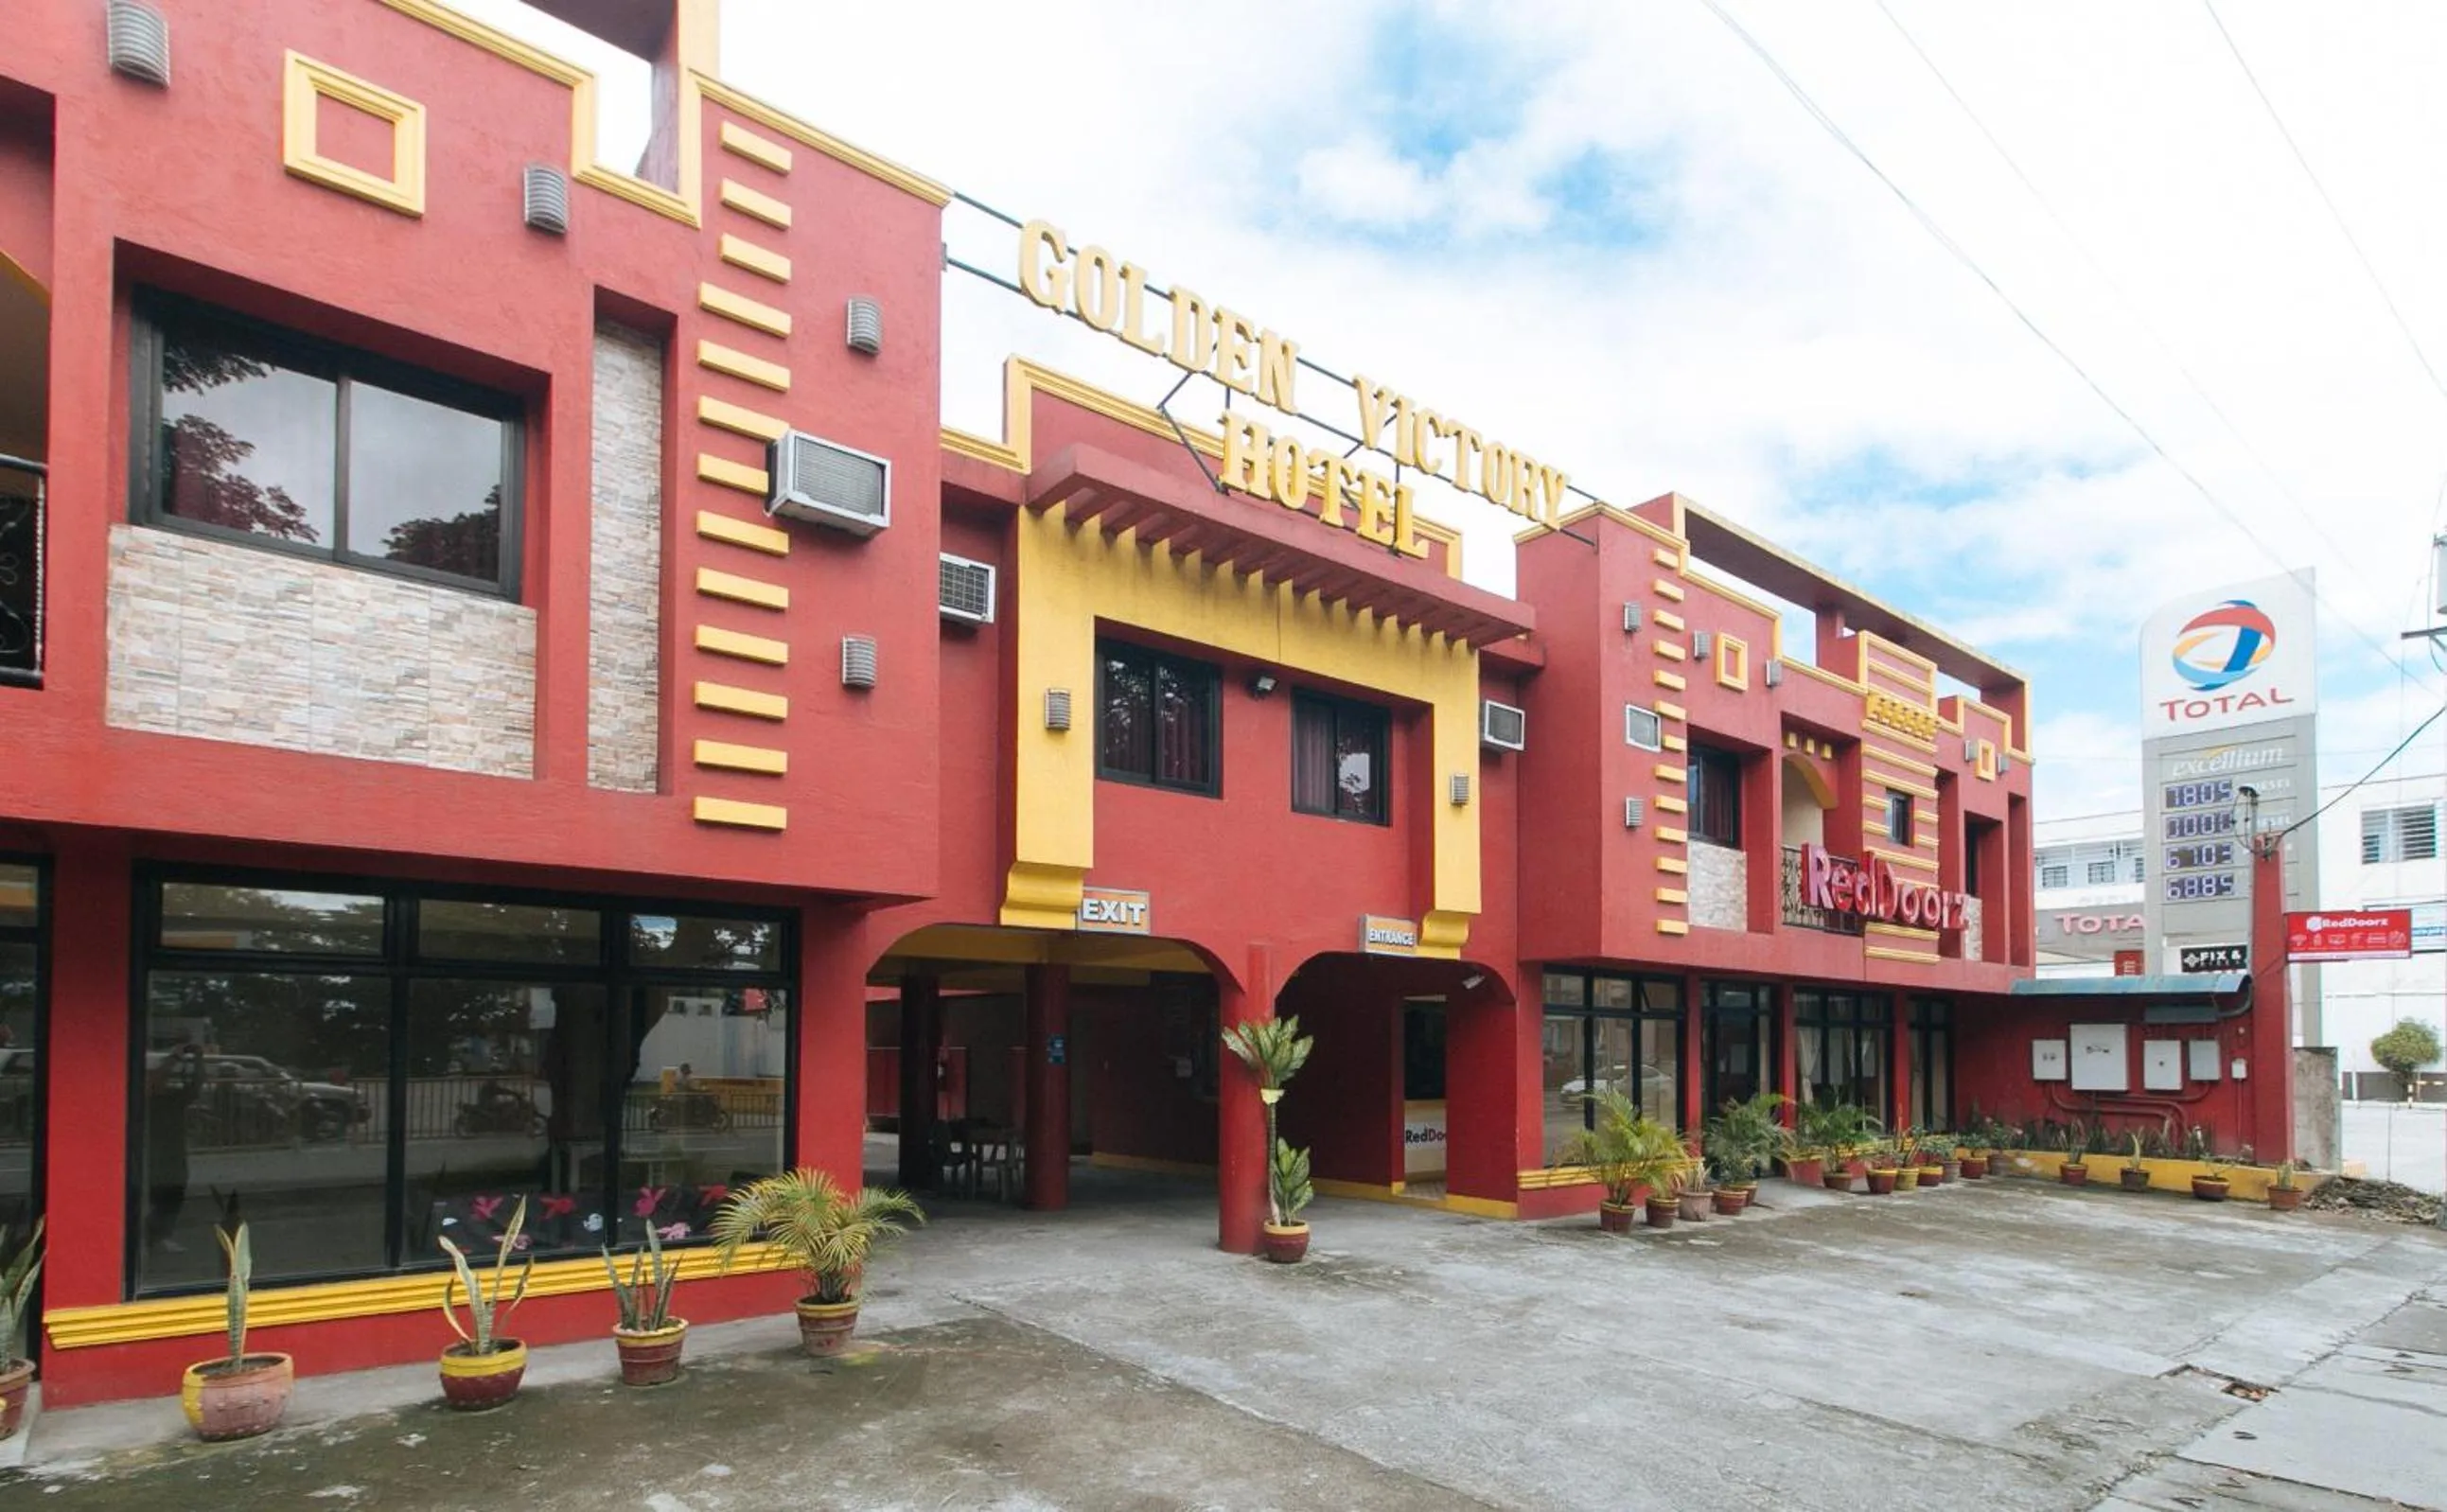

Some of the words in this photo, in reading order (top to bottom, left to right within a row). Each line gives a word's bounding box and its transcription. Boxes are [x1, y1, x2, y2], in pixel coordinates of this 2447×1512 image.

[1018, 219, 1300, 415] GOLDEN
[1352, 374, 1573, 531] VICTORY
[1218, 410, 1431, 559] HOTEL
[2159, 687, 2295, 722] TOTAL
[2173, 747, 2283, 776] excellium
[1802, 843, 1970, 930] RedDoorz
[1082, 898, 1147, 926] EXIT
[2322, 917, 2389, 929] RedDoorz
[1369, 927, 1417, 946] ENTRANCE
[2200, 951, 2227, 961] FIX
